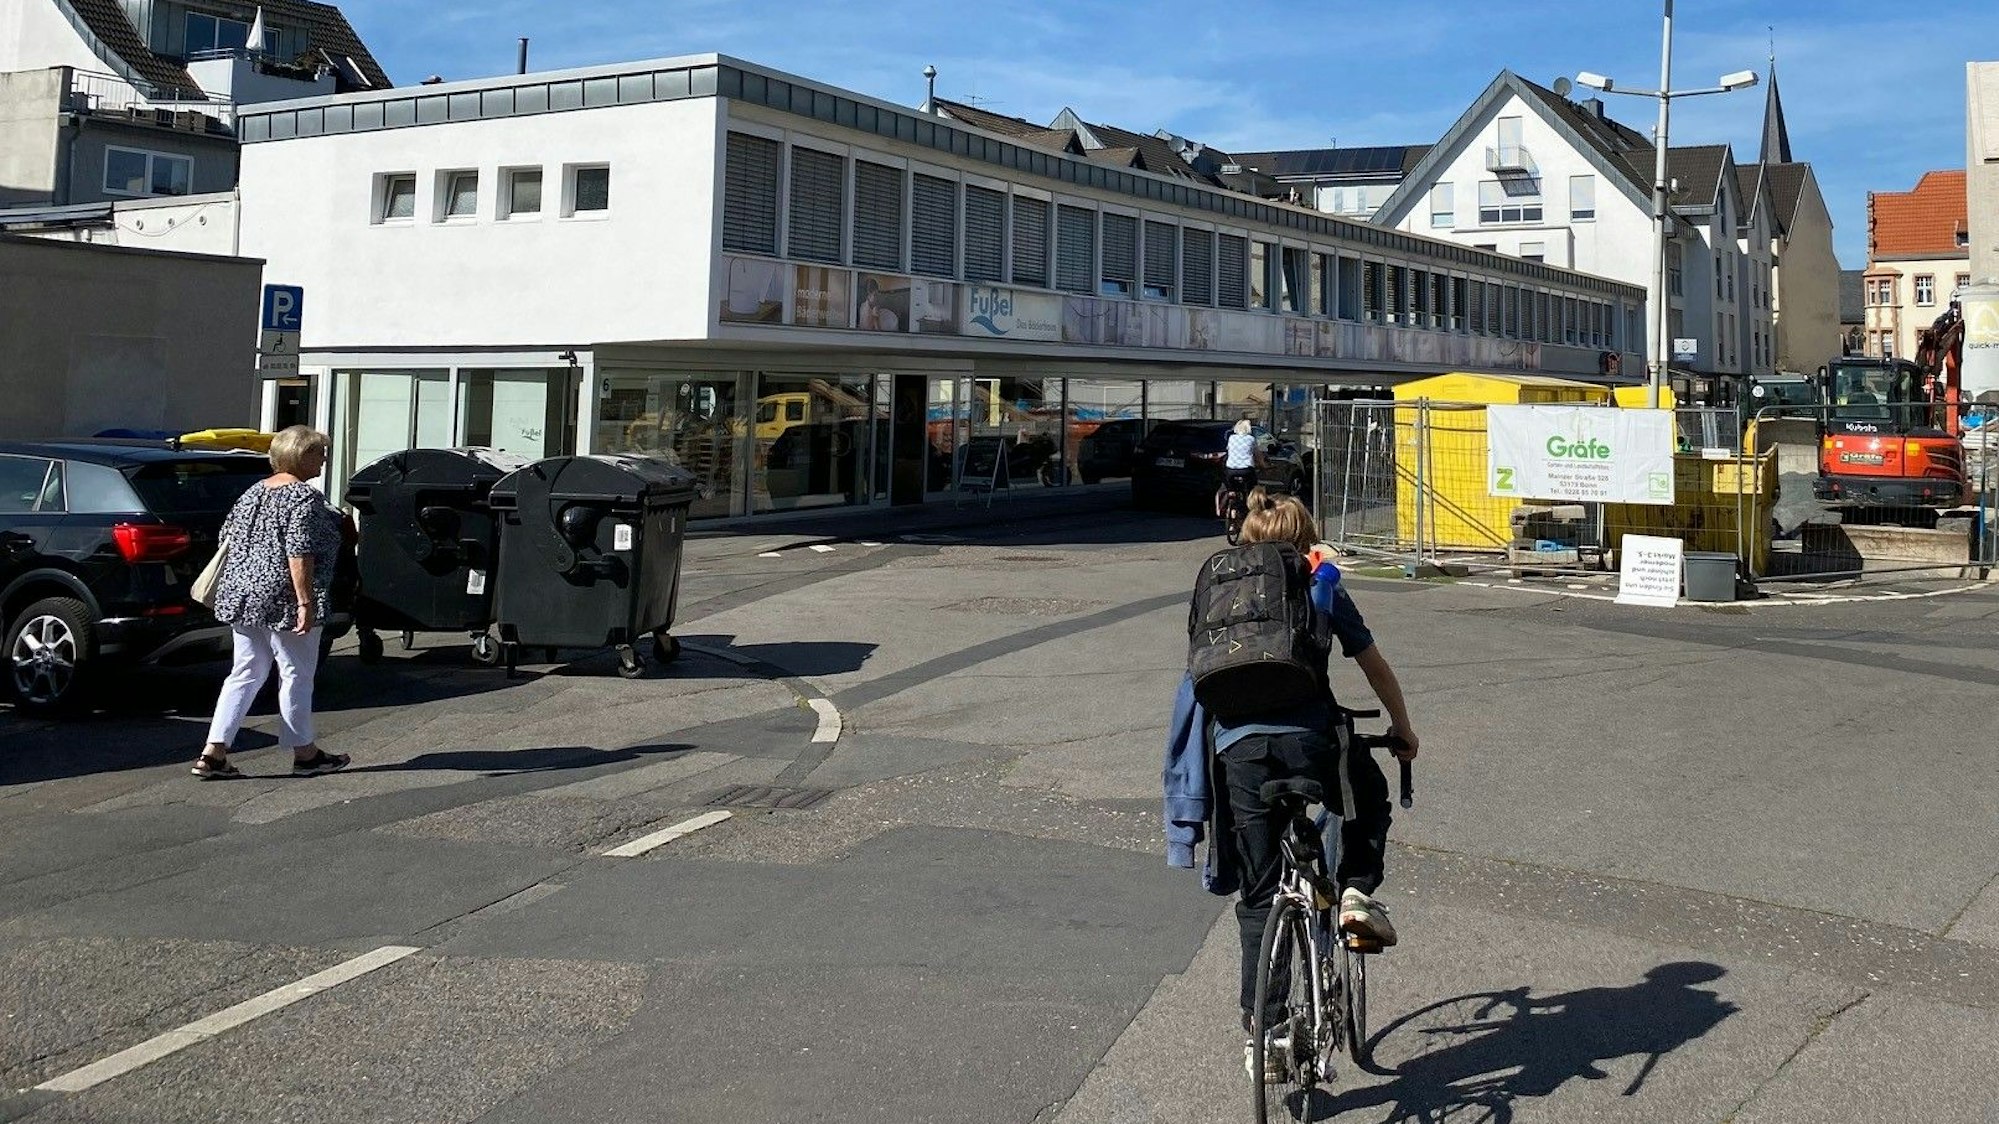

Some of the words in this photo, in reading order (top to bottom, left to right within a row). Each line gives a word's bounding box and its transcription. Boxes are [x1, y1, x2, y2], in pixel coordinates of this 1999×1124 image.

[272, 290, 295, 327] P
[970, 287, 1013, 318] Fußel
[602, 378, 610, 392] 6
[1845, 423, 1878, 433] Kubota
[1546, 435, 1611, 459] Gräfe
